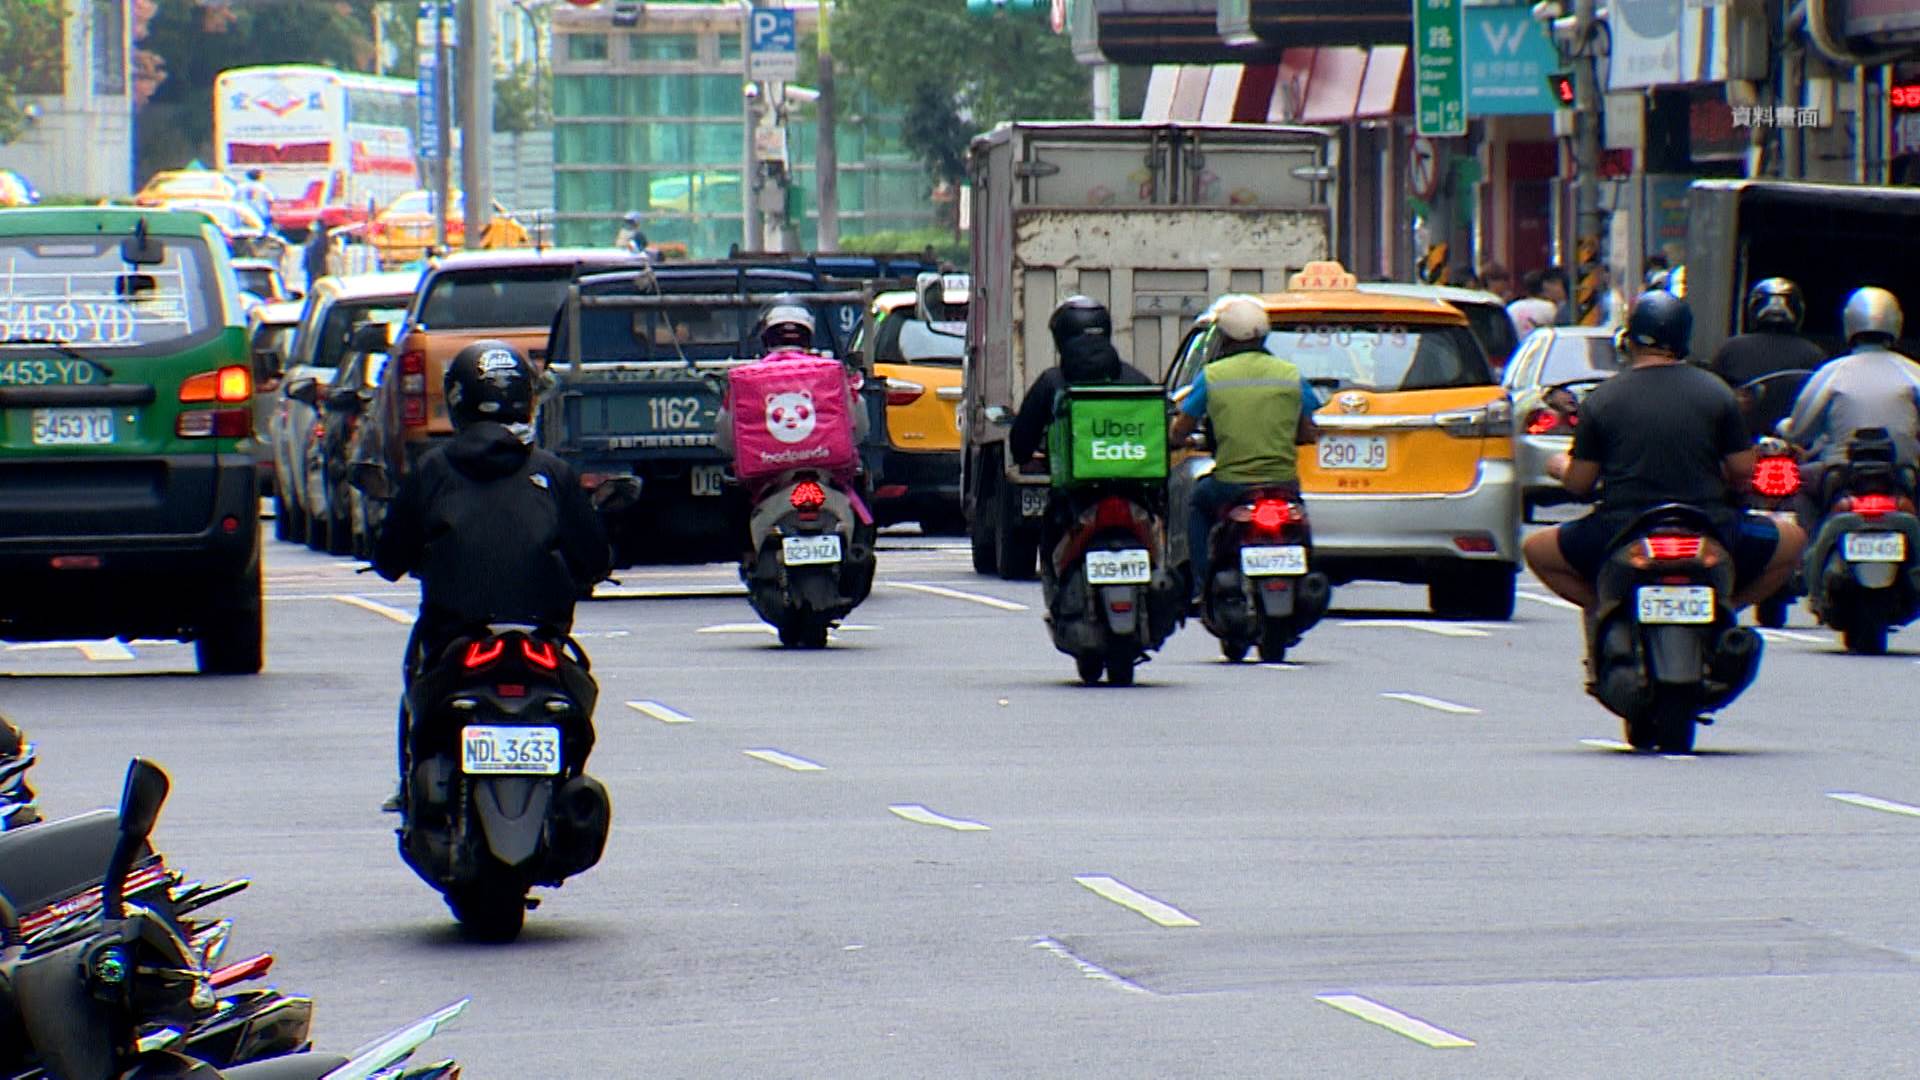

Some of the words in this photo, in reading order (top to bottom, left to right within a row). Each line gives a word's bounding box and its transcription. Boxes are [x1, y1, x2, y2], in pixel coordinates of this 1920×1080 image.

[755, 13, 776, 44] P
[1299, 277, 1349, 288] TAXI
[840, 305, 854, 332] 9
[0, 360, 94, 385] 453-YD
[649, 397, 720, 430] 1162-
[1092, 418, 1145, 437] Uber
[761, 446, 830, 463] foodpanda
[1092, 441, 1147, 461] Eats
[466, 738, 556, 763] NDL-3633
